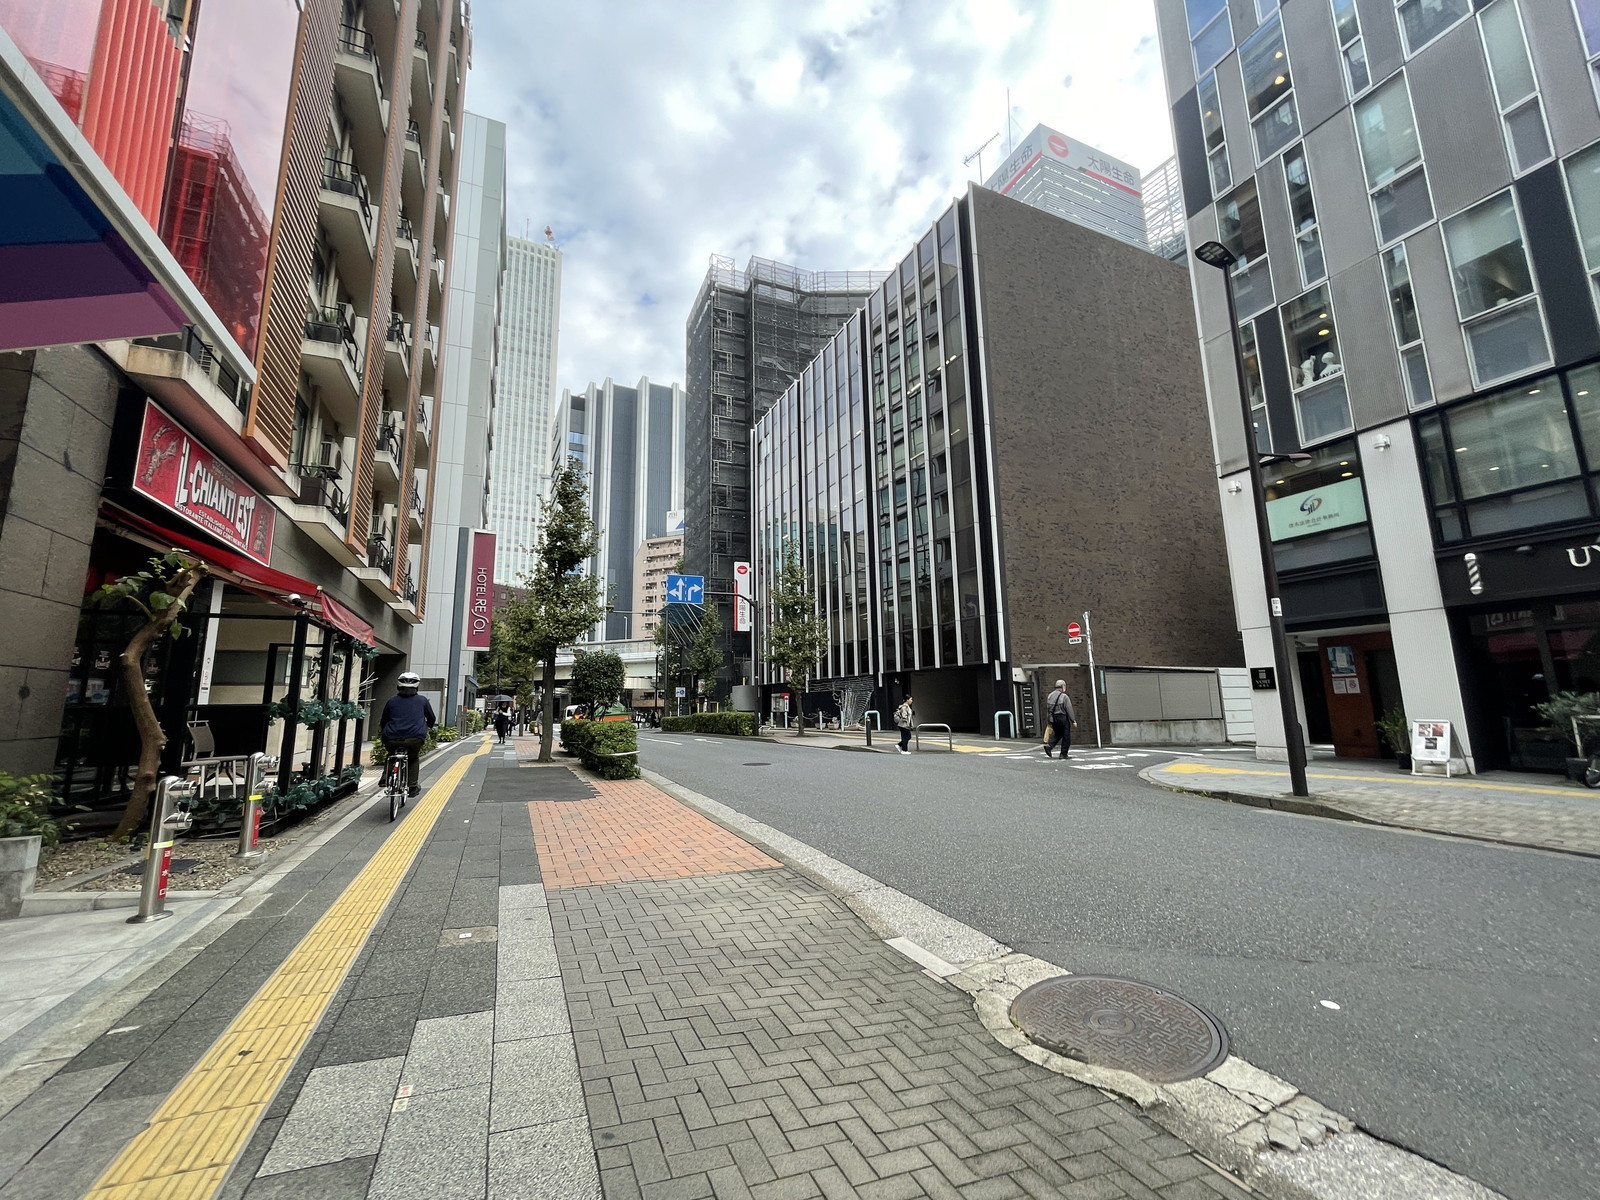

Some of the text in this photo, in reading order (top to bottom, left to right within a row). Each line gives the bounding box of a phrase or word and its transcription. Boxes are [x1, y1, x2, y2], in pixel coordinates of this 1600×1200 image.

[1087, 155, 1135, 187] 太陽生命
[176, 502, 204, 523] RISTORANTE
[204, 519, 223, 536] ITALIANO
[199, 510, 225, 530] ESTABLISHED
[235, 495, 256, 549] EST
[471, 567, 489, 635] HOTEL RESOL
